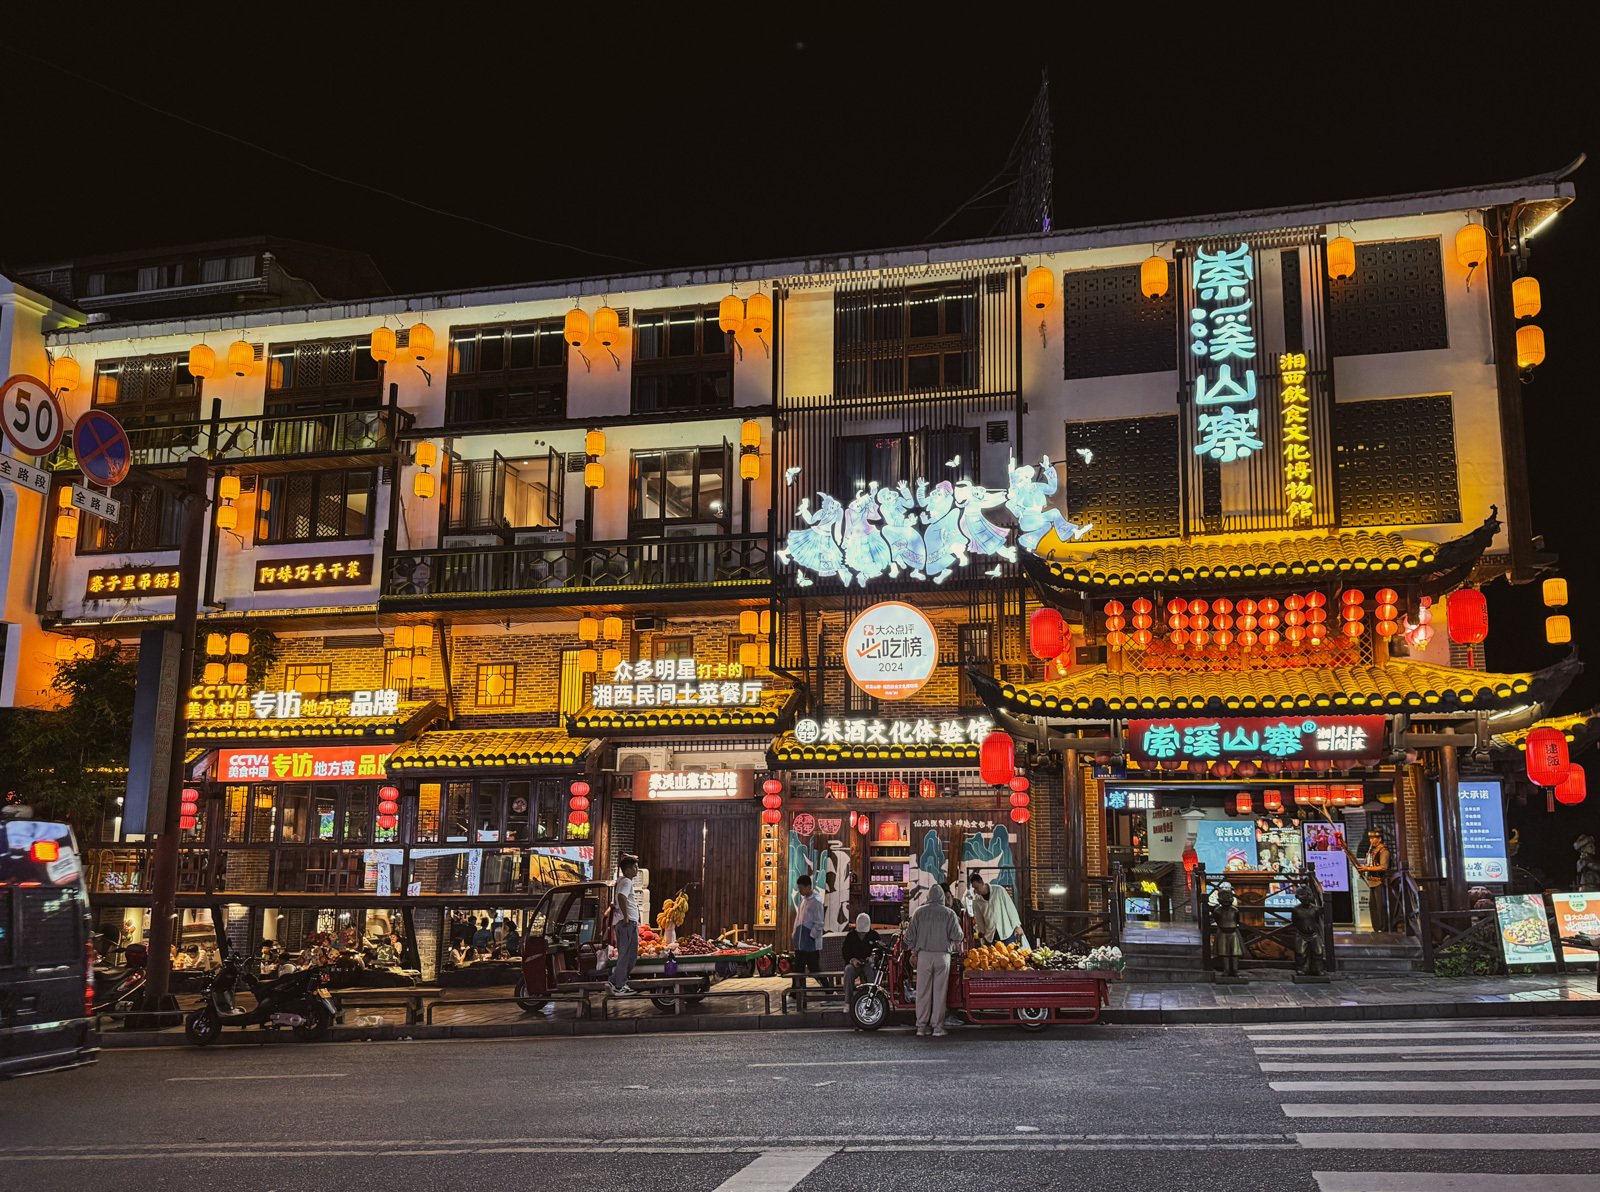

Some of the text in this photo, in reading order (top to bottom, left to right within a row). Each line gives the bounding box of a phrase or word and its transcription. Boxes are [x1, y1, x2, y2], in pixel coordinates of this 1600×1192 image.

[1190, 242, 1263, 463] 索溪山寨
[13, 387, 52, 442] 50
[0, 461, 46, 490] 全路段
[76, 491, 116, 517] 全路段
[260, 561, 360, 584] 阿妹巧手干菜
[876, 624, 914, 635] 大众点评
[856, 637, 922, 658] 必吃榜
[614, 659, 743, 681] 众多明星打卡的
[879, 662, 903, 672] 2024
[191, 685, 248, 699] CCTV4
[592, 682, 763, 706] 湘西民间土菜餐厅
[188, 700, 250, 718] 美食中国
[820, 717, 994, 744] 米酒文化体验馆
[229, 754, 269, 766] CCTV4
[228, 766, 269, 778] 美食中国
[1459, 790, 1489, 799] 大承诺
